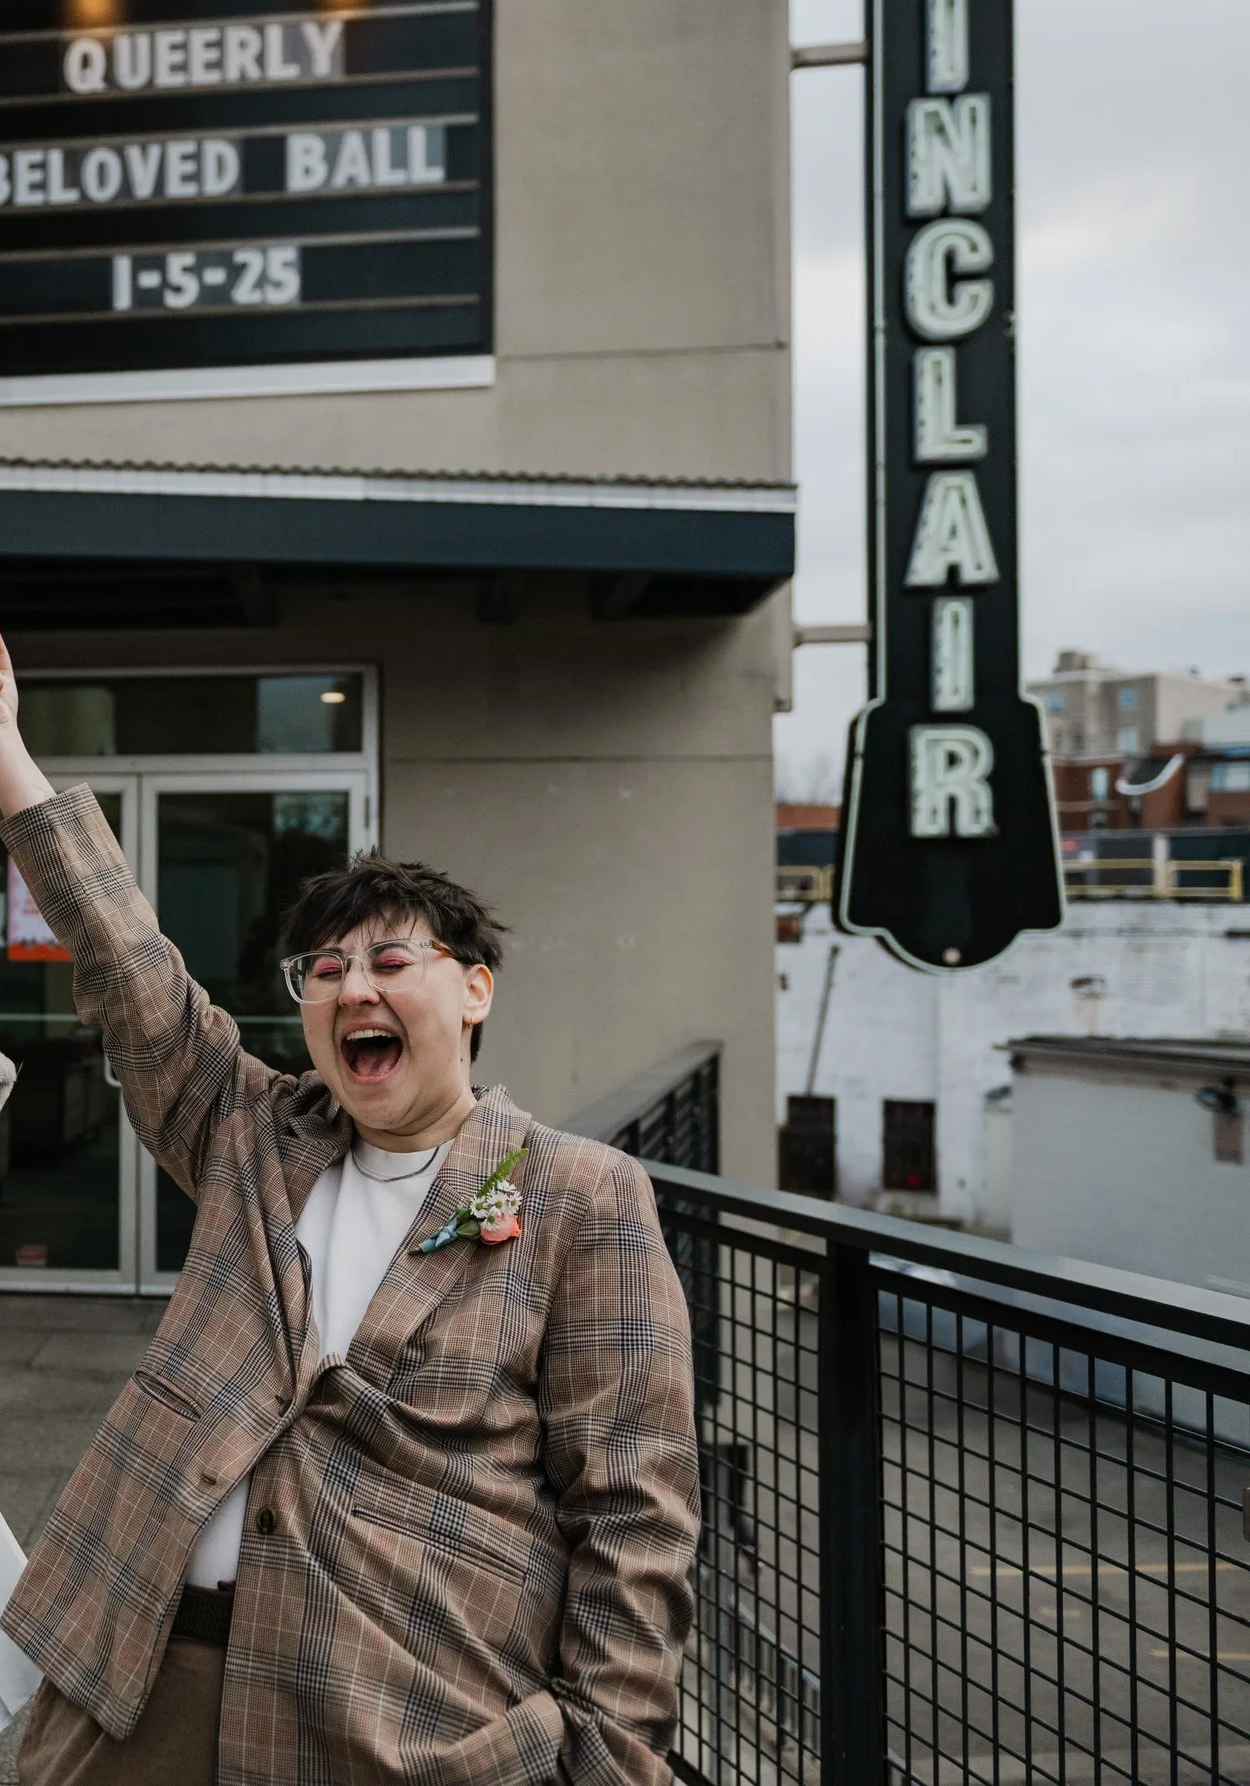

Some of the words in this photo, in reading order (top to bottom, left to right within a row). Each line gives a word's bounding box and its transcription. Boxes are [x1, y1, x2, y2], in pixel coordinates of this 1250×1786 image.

[63, 19, 346, 94] QUEERLY
[285, 125, 446, 193] BALL
[112, 245, 302, 311] 1-5-25
[904, 0, 1001, 838] INCLAIR
